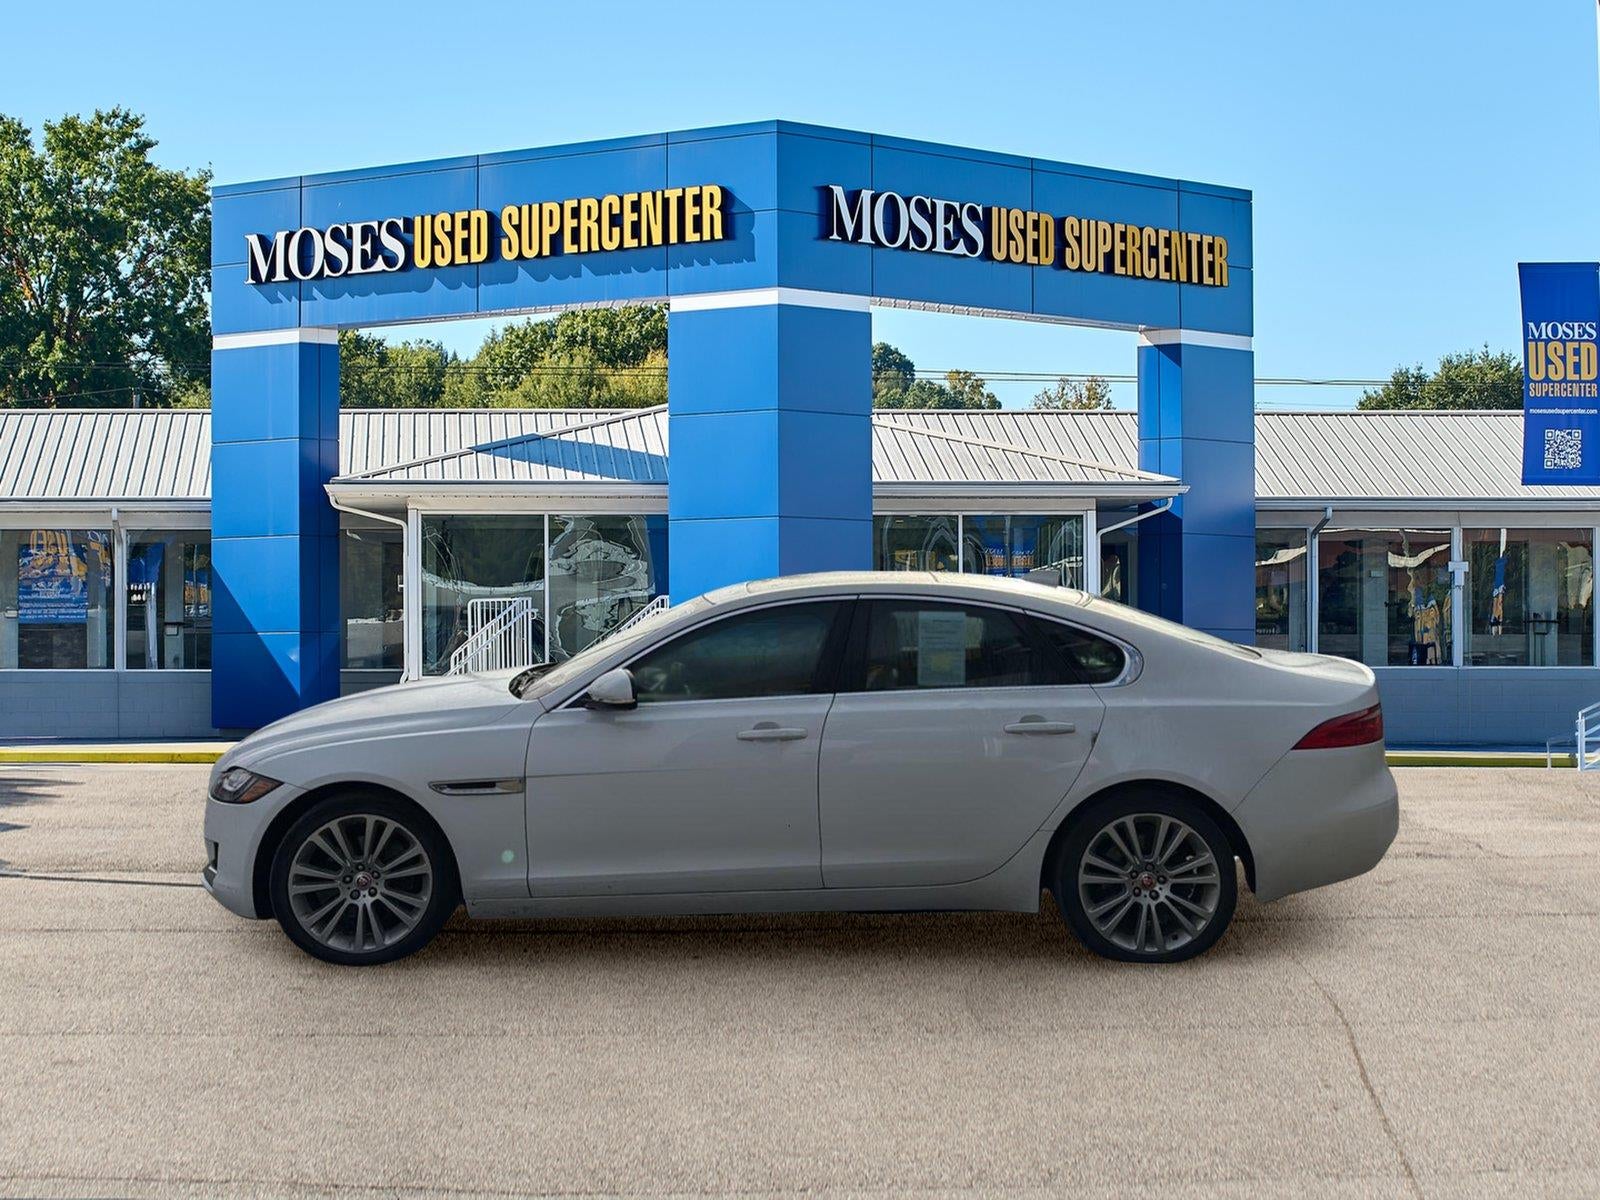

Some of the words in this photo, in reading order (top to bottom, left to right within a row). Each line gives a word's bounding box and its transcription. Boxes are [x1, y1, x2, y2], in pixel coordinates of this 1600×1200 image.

[244, 217, 408, 285] MOSES
[413, 208, 489, 269] USED
[500, 184, 724, 261] SUPERCENTER
[828, 184, 985, 258] MOSES
[990, 206, 1056, 266] USED
[1064, 215, 1229, 288] SUPERCENTER
[1528, 322, 1597, 340] MOSES
[1529, 342, 1597, 381] USED
[1530, 383, 1598, 397] SUPERCENTER
